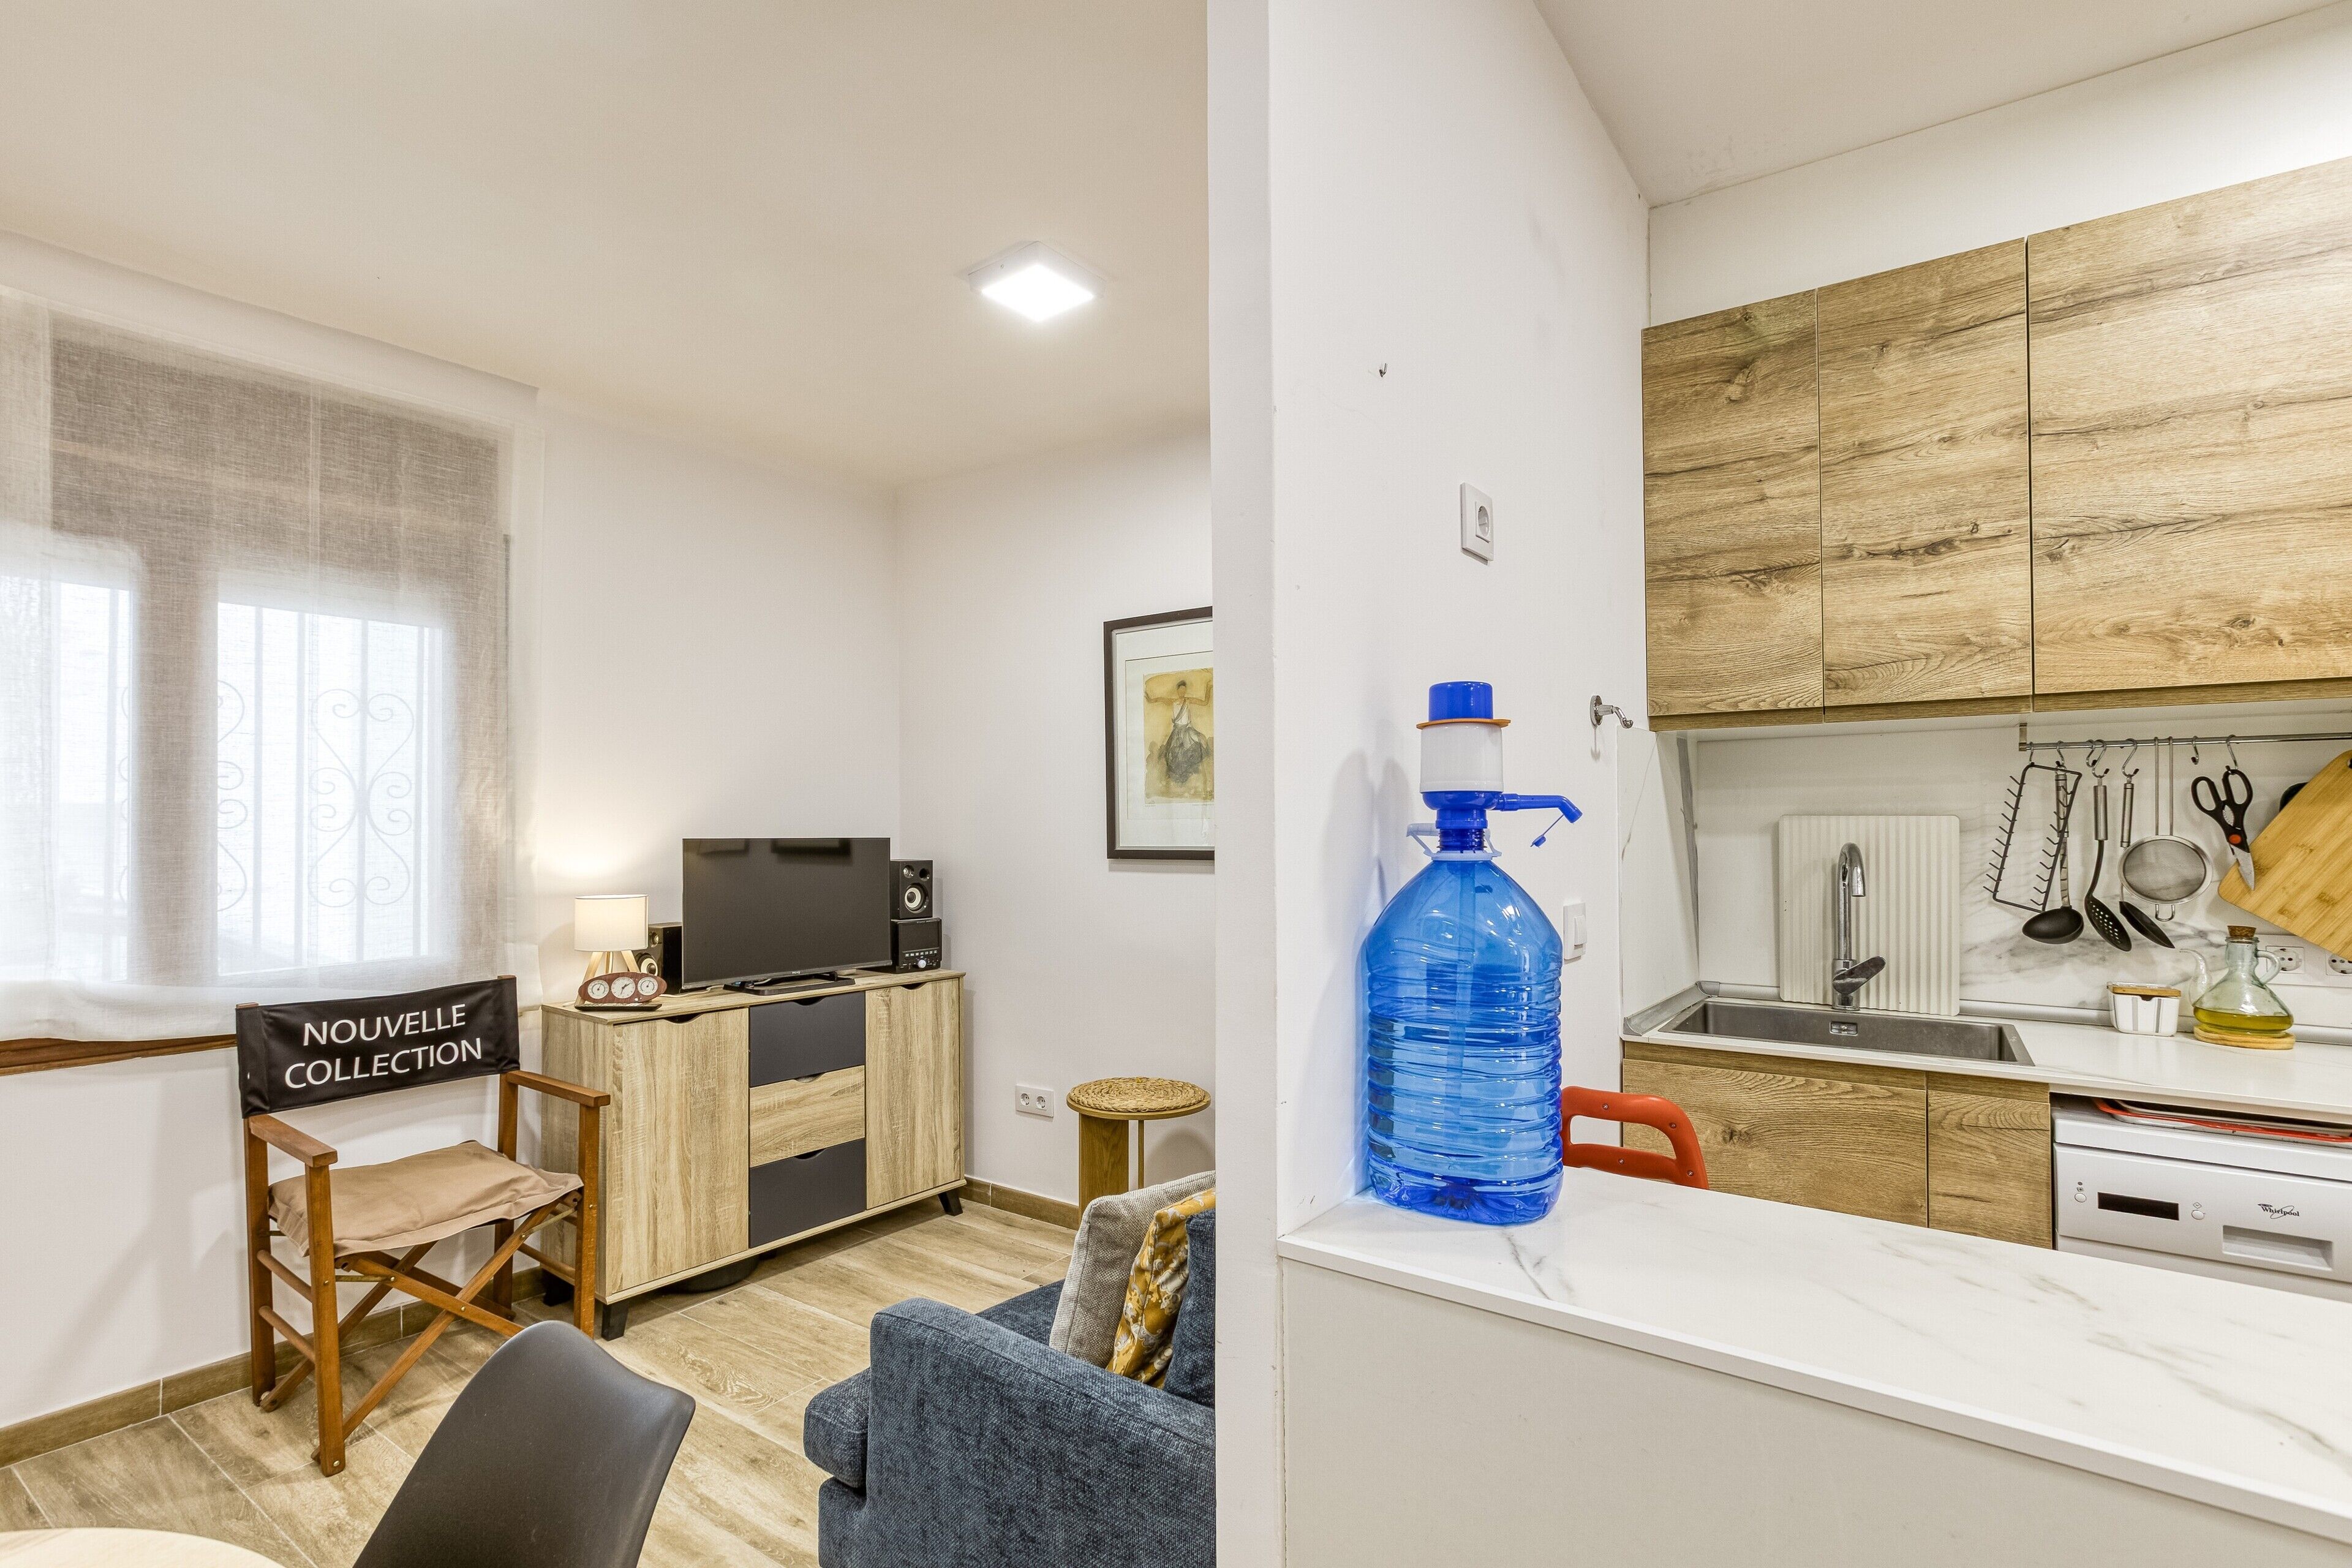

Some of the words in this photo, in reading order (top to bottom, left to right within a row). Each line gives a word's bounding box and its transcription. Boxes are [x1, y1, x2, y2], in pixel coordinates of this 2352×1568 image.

[303, 1003, 466, 1046] NOUVELLE
[285, 1037, 482, 1088] COLLECTION
[2261, 1207, 2299, 1216] Whirlpool
